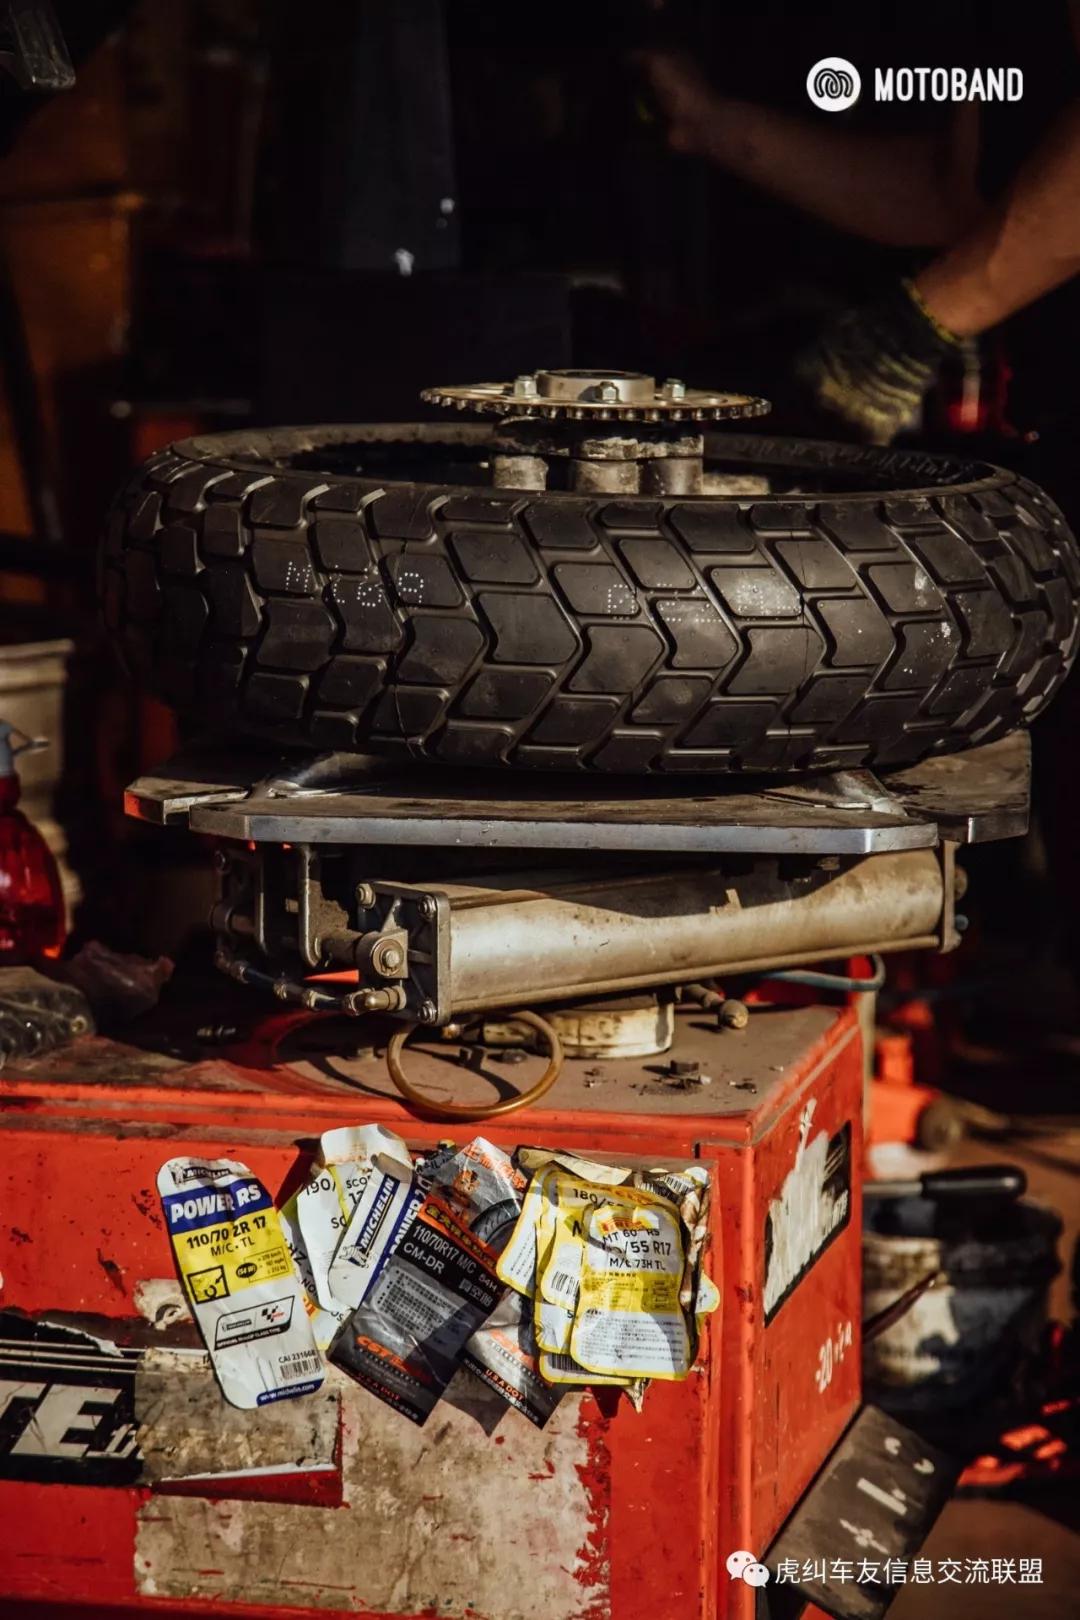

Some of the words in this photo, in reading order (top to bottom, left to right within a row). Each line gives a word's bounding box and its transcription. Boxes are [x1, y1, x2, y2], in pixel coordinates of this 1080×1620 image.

[171, 1194, 236, 1224] POWER
[236, 1184, 262, 1207] RS
[359, 1177, 396, 1249] MICHELIN
[187, 1228, 229, 1250] 110/70
[233, 1221, 251, 1237] ZR
[253, 1215, 266, 1230] 17
[211, 1243, 233, 1257] M/C
[240, 1236, 255, 1248] TL
[653, 1241, 672, 1257] R17
[403, 1242, 445, 1275] CM-DR
[412, 1225, 460, 1261] 110/70R17
[457, 1254, 477, 1274] M/C
[636, 1259, 653, 1270] 73H
[656, 1260, 667, 1271] TL
[504, 1382, 525, 1401] DOT
